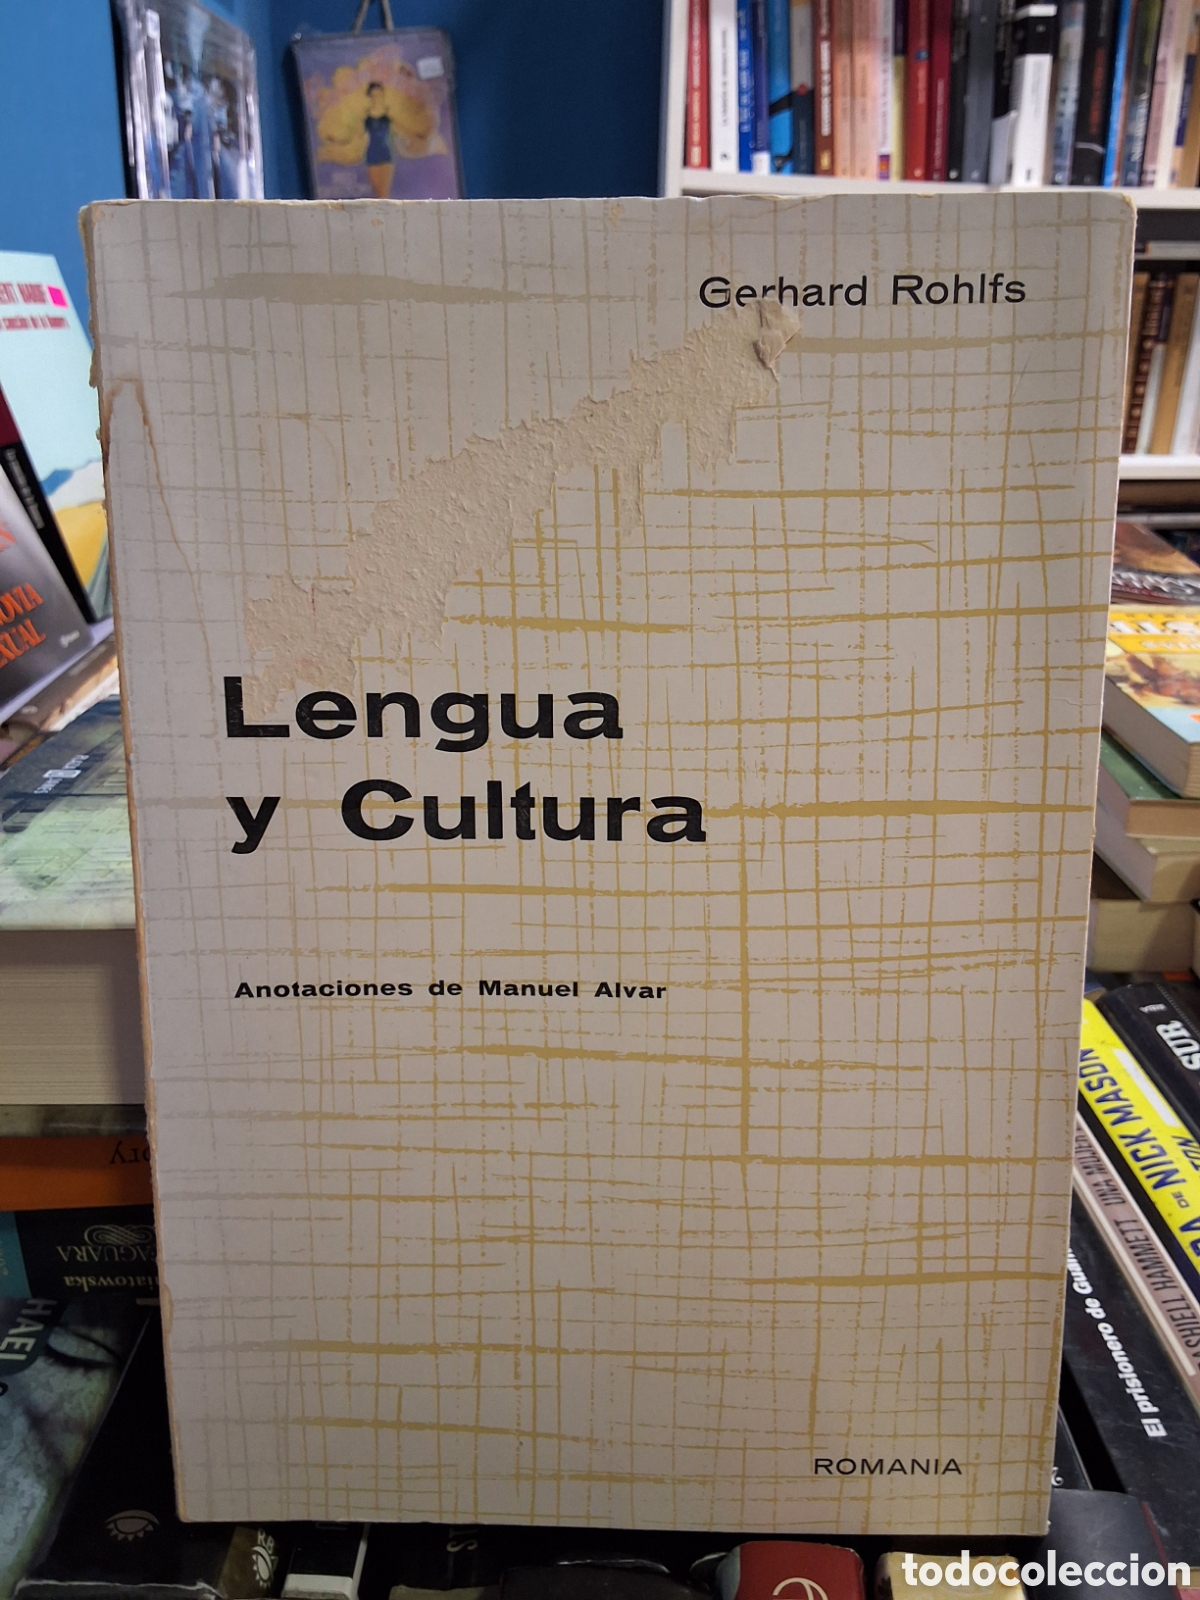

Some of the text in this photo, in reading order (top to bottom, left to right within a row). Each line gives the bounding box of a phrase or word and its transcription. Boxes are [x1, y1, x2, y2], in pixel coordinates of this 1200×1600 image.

[699, 272, 1026, 308] Gerhard Rohlfs
[223, 676, 623, 753] Lengua
[225, 778, 707, 855] y Cultura
[234, 979, 667, 999] Anotaciones de Manuel Alvar
[1118, 1128, 1187, 1191] NICK
[1171, 1191, 1190, 1209] DE
[1113, 1218, 1179, 1292] HAMMETT
[1084, 1297, 1107, 1320] de
[1097, 1322, 1160, 1414] prisionero
[1141, 1418, 1168, 1438] El
[814, 1457, 962, 1475] ROMANIA
